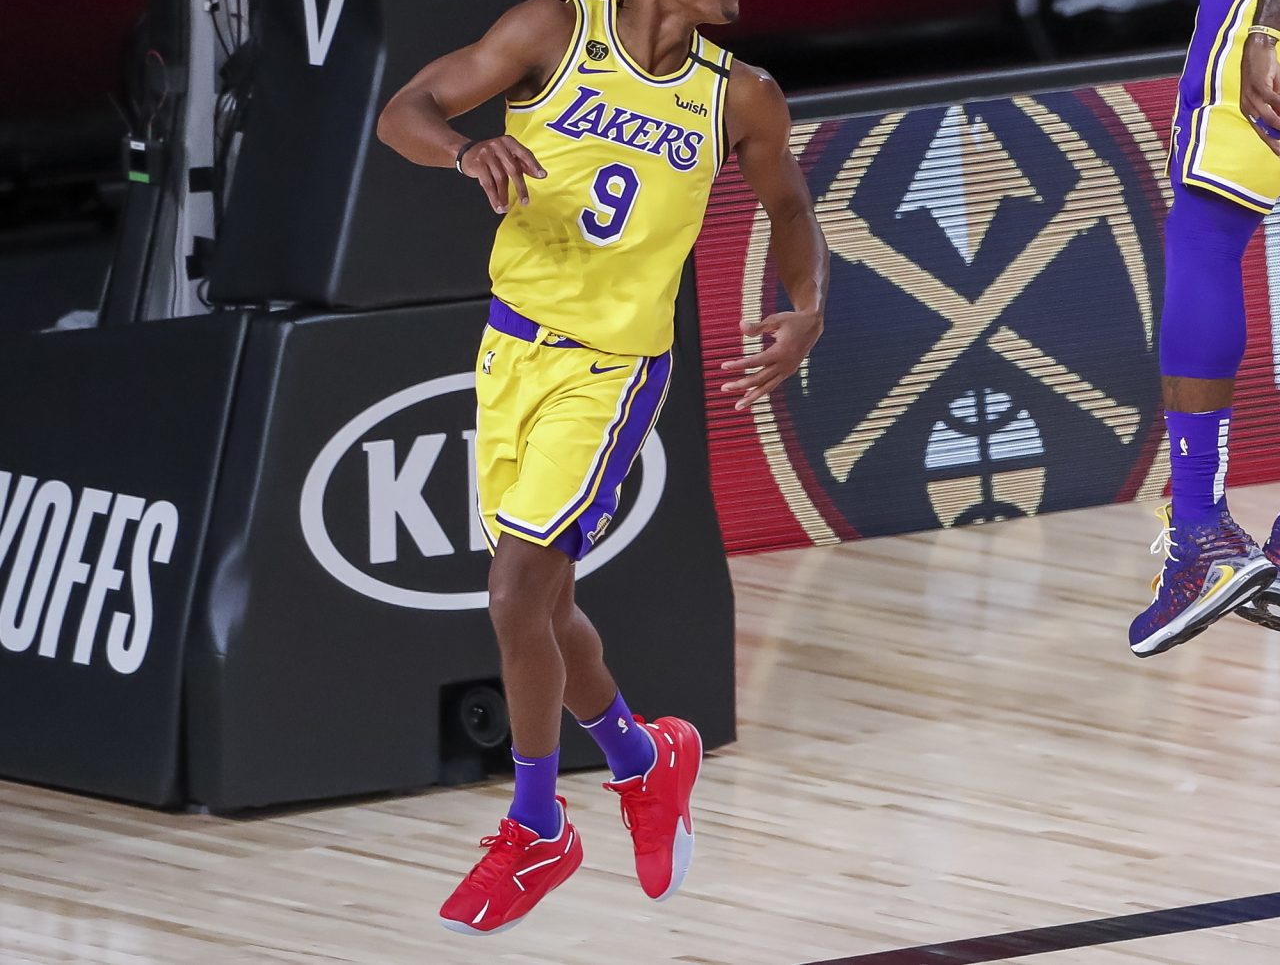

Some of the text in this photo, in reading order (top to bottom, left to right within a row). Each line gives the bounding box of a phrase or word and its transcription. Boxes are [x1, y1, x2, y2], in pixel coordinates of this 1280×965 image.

[544, 84, 706, 172] LAKERS
[674, 94, 708, 117] wish
[577, 161, 641, 247] 9
